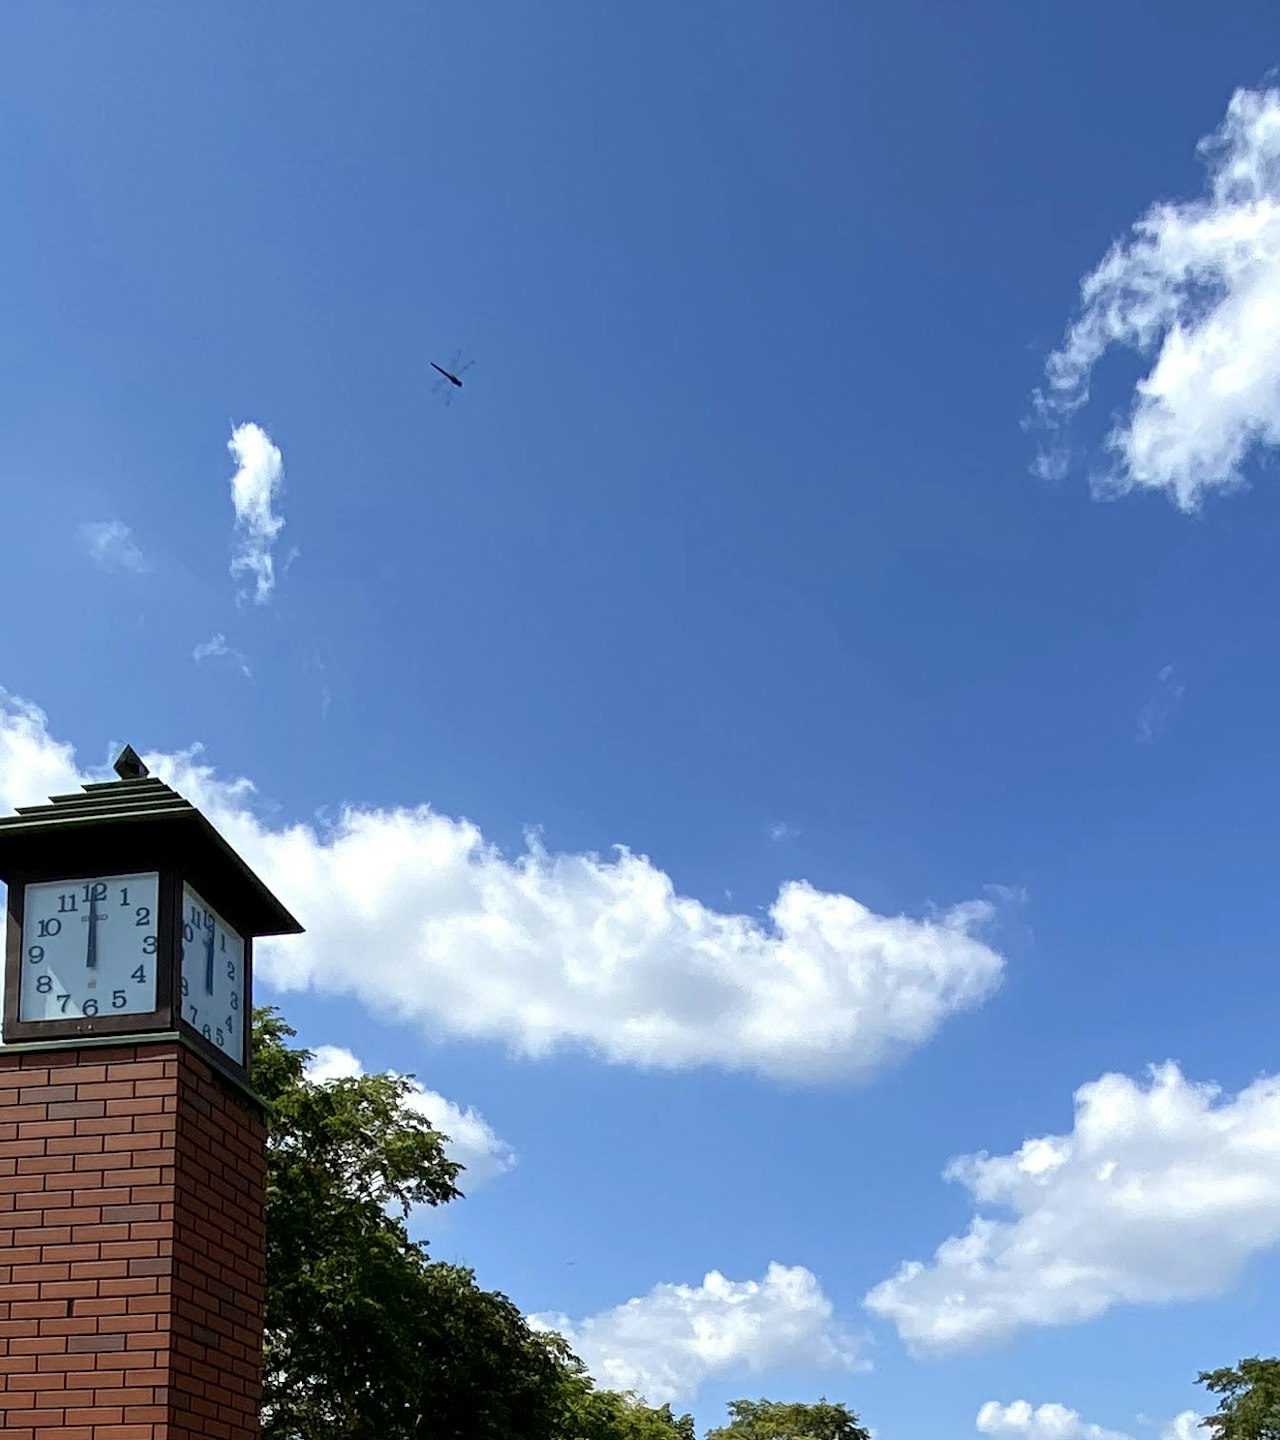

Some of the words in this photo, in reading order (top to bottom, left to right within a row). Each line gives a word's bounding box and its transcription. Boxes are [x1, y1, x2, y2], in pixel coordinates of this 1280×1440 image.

[82, 882, 107, 903] 12
[120, 888, 130, 906] 1
[58, 894, 78, 912] 11
[135, 907, 150, 926] 2
[192, 906, 201, 930] 11
[37, 918, 62, 937] 10
[142, 936, 158, 954] 3
[221, 934, 226, 953] 1
[28, 945, 45, 964] 9
[130, 964, 146, 983] 4
[227, 961, 235, 980] 2
[36, 975, 52, 994] 8
[56, 994, 71, 1013] 7
[82, 998, 99, 1017] 6
[111, 990, 127, 1008] 5
[230, 991, 238, 1010] 3
[189, 1005, 198, 1025] 7
[225, 1015, 233, 1034] 4
[216, 1027, 224, 1047] 5
